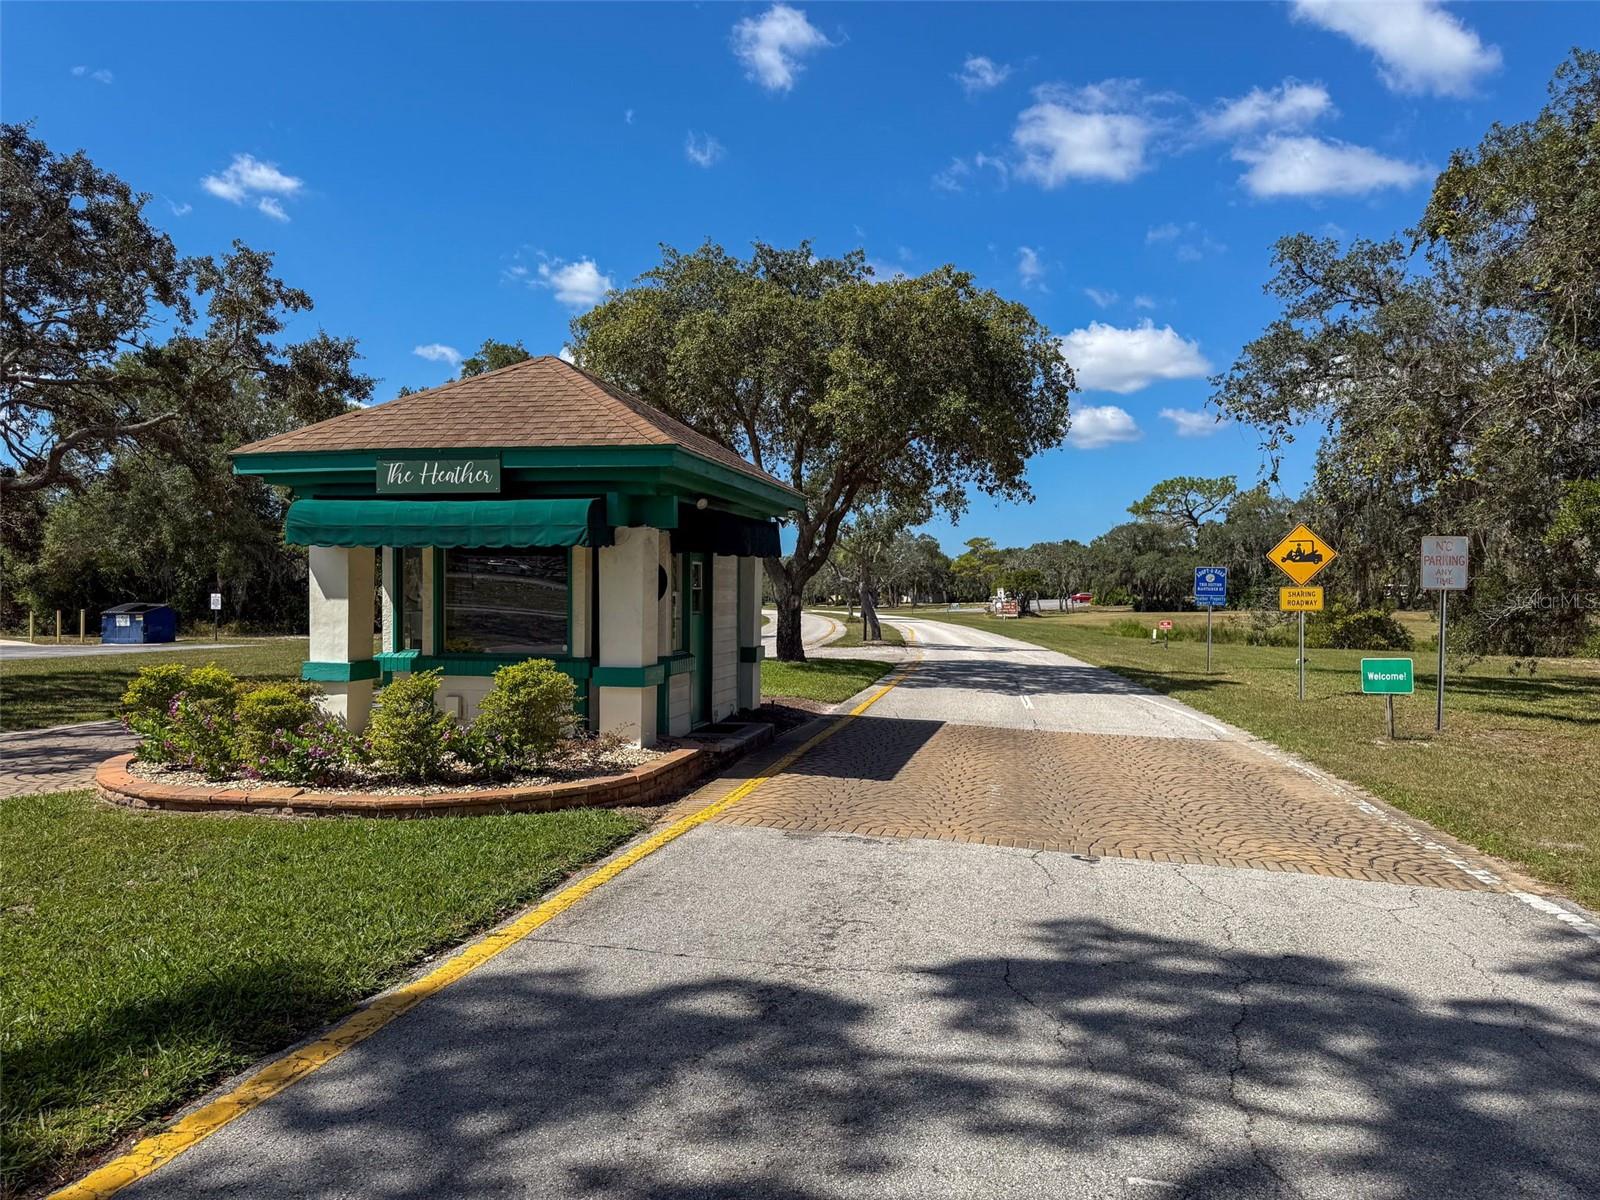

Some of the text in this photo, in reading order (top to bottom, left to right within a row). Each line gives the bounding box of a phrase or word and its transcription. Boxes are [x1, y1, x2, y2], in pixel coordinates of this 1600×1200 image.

[383, 461, 493, 485] The Heather
[1424, 555, 1466, 567] PARKING
[1367, 671, 1407, 681] Welcome!
